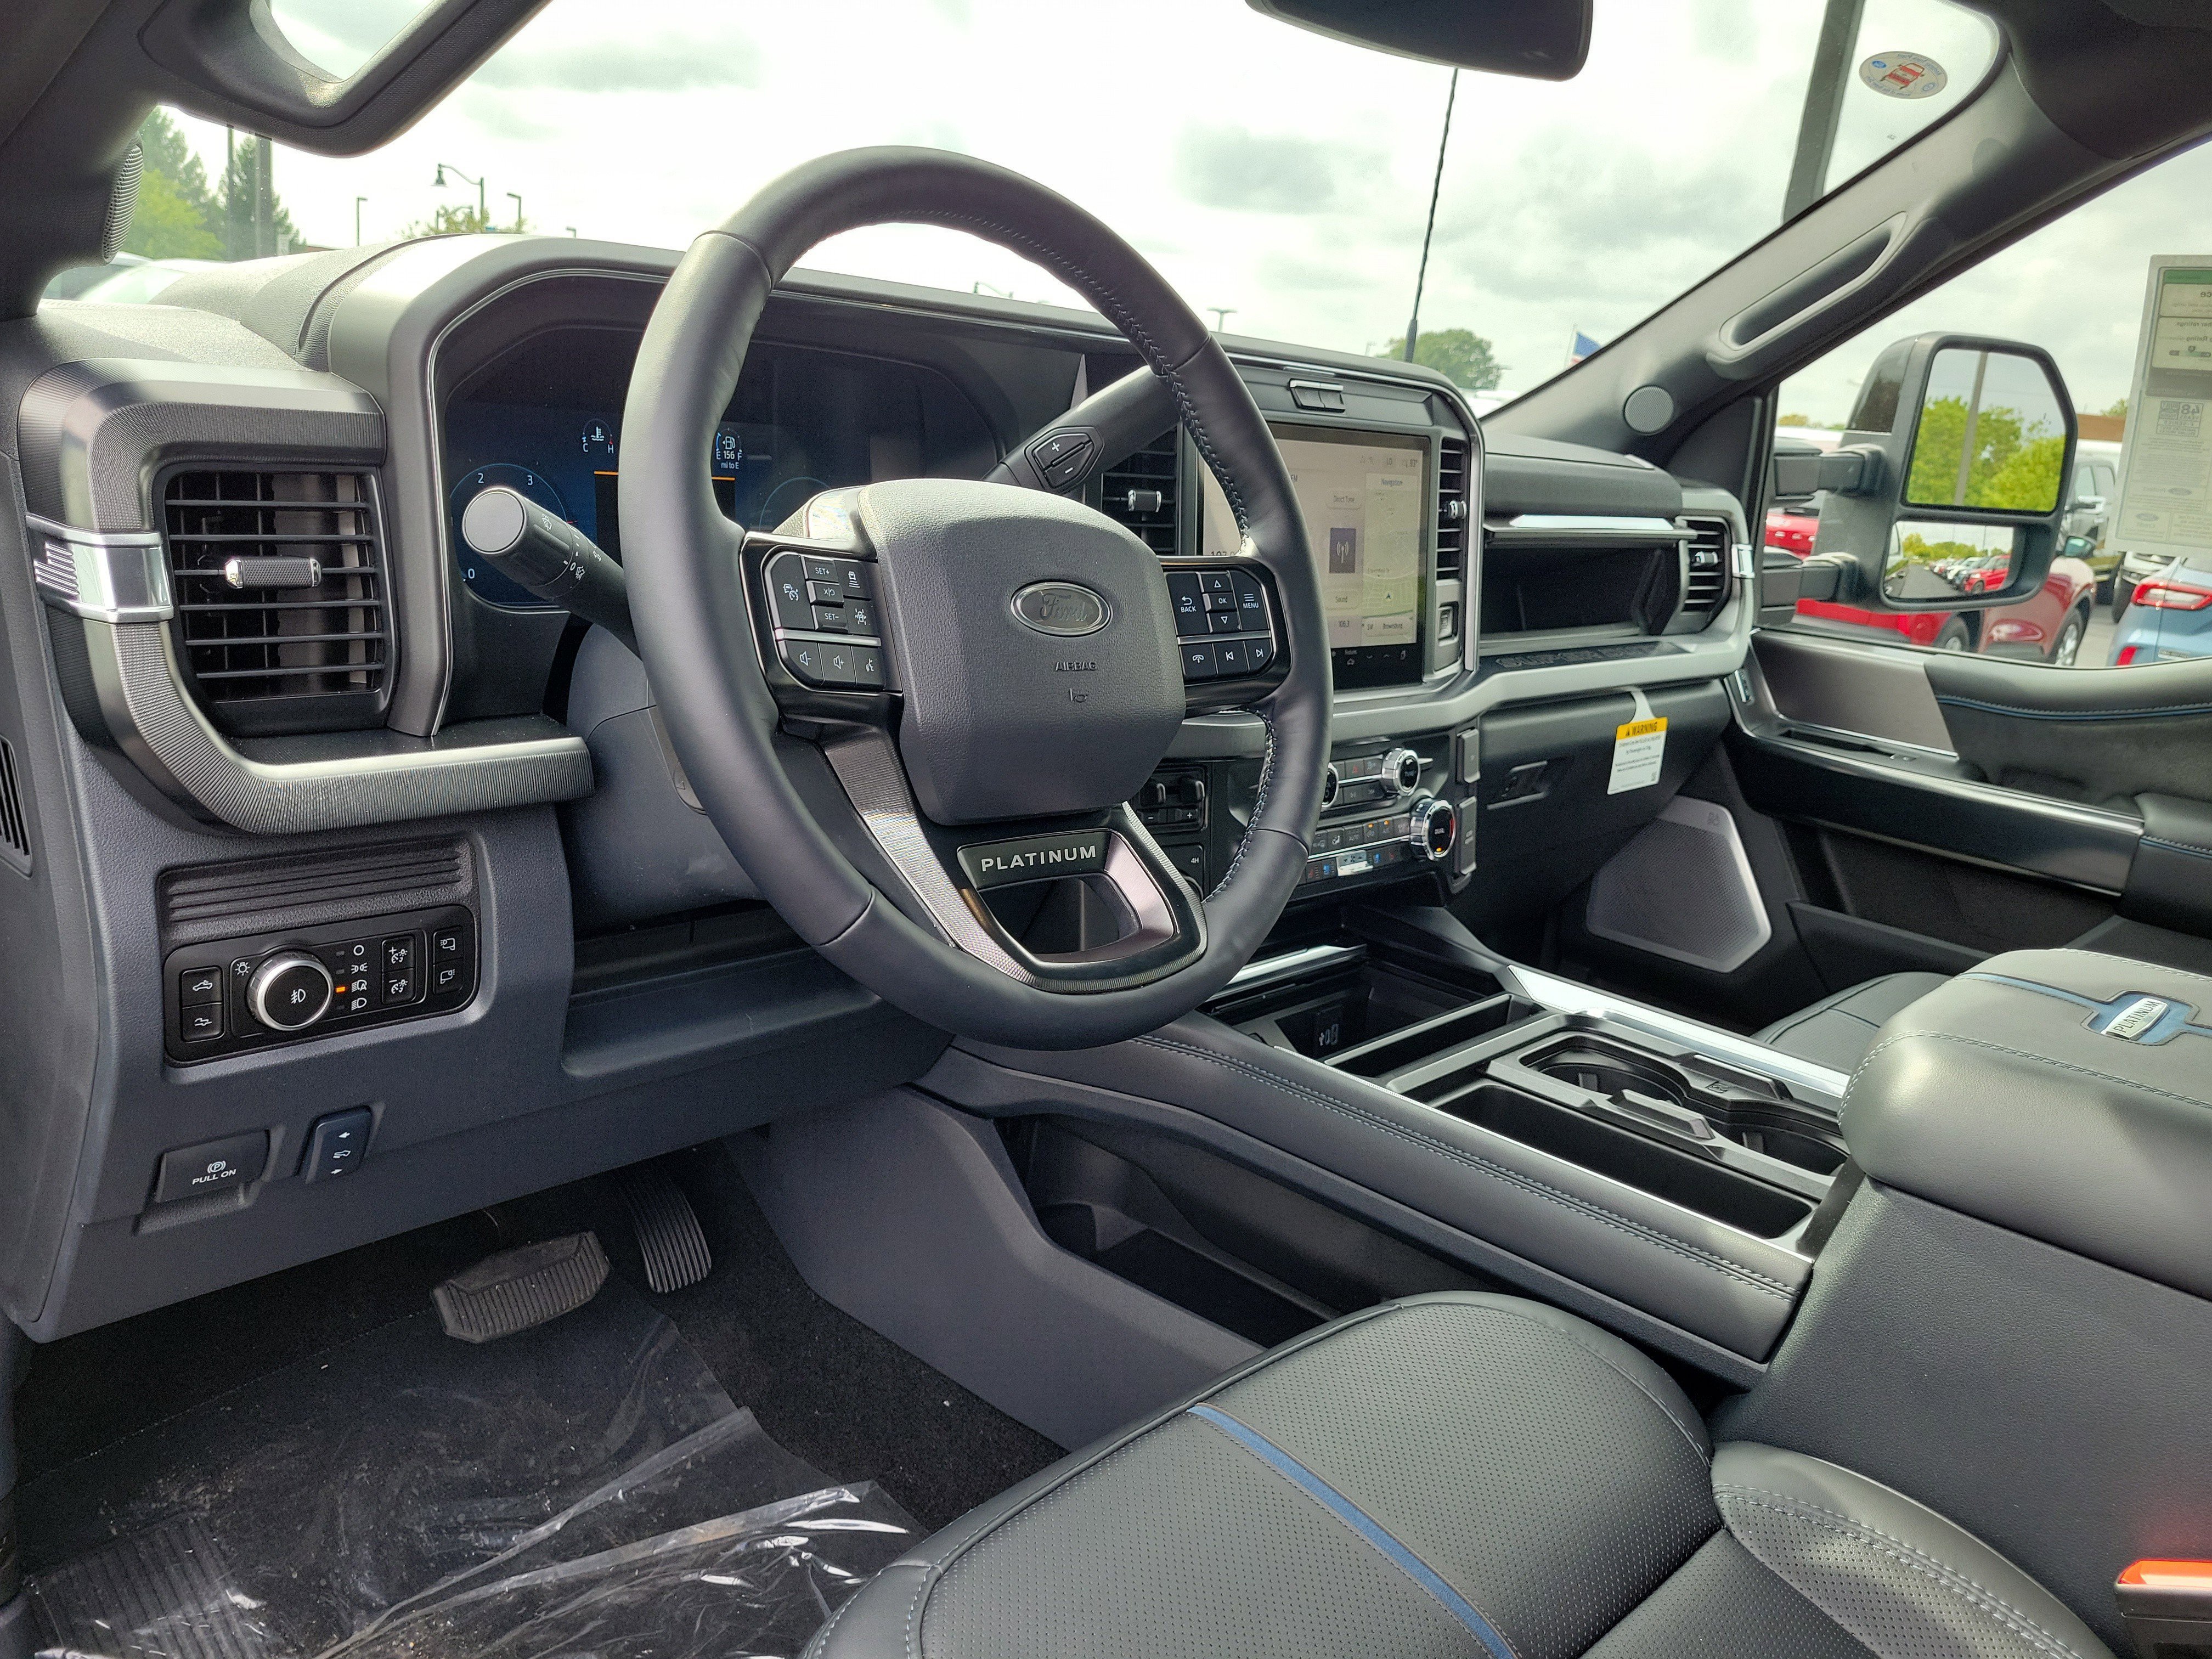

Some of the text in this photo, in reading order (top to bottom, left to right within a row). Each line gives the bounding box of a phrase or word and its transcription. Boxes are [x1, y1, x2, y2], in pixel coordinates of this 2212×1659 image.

[582, 444, 589, 453] C
[607, 444, 614, 454] H
[716, 451, 721, 460] E
[723, 450, 735, 460] 156
[737, 453, 742, 461] F
[477, 473, 484, 484] 2
[527, 475, 533, 486] 3
[467, 568, 475, 579] 0
[1034, 590, 1088, 622] Ford
[1054, 661, 1098, 672] AIRBAG
[1632, 721, 1658, 736] WARNING
[980, 845, 1096, 872] PLATINUM
[2113, 1000, 2160, 1033] PLATINUM
[192, 1168, 237, 1185] PULL ON
